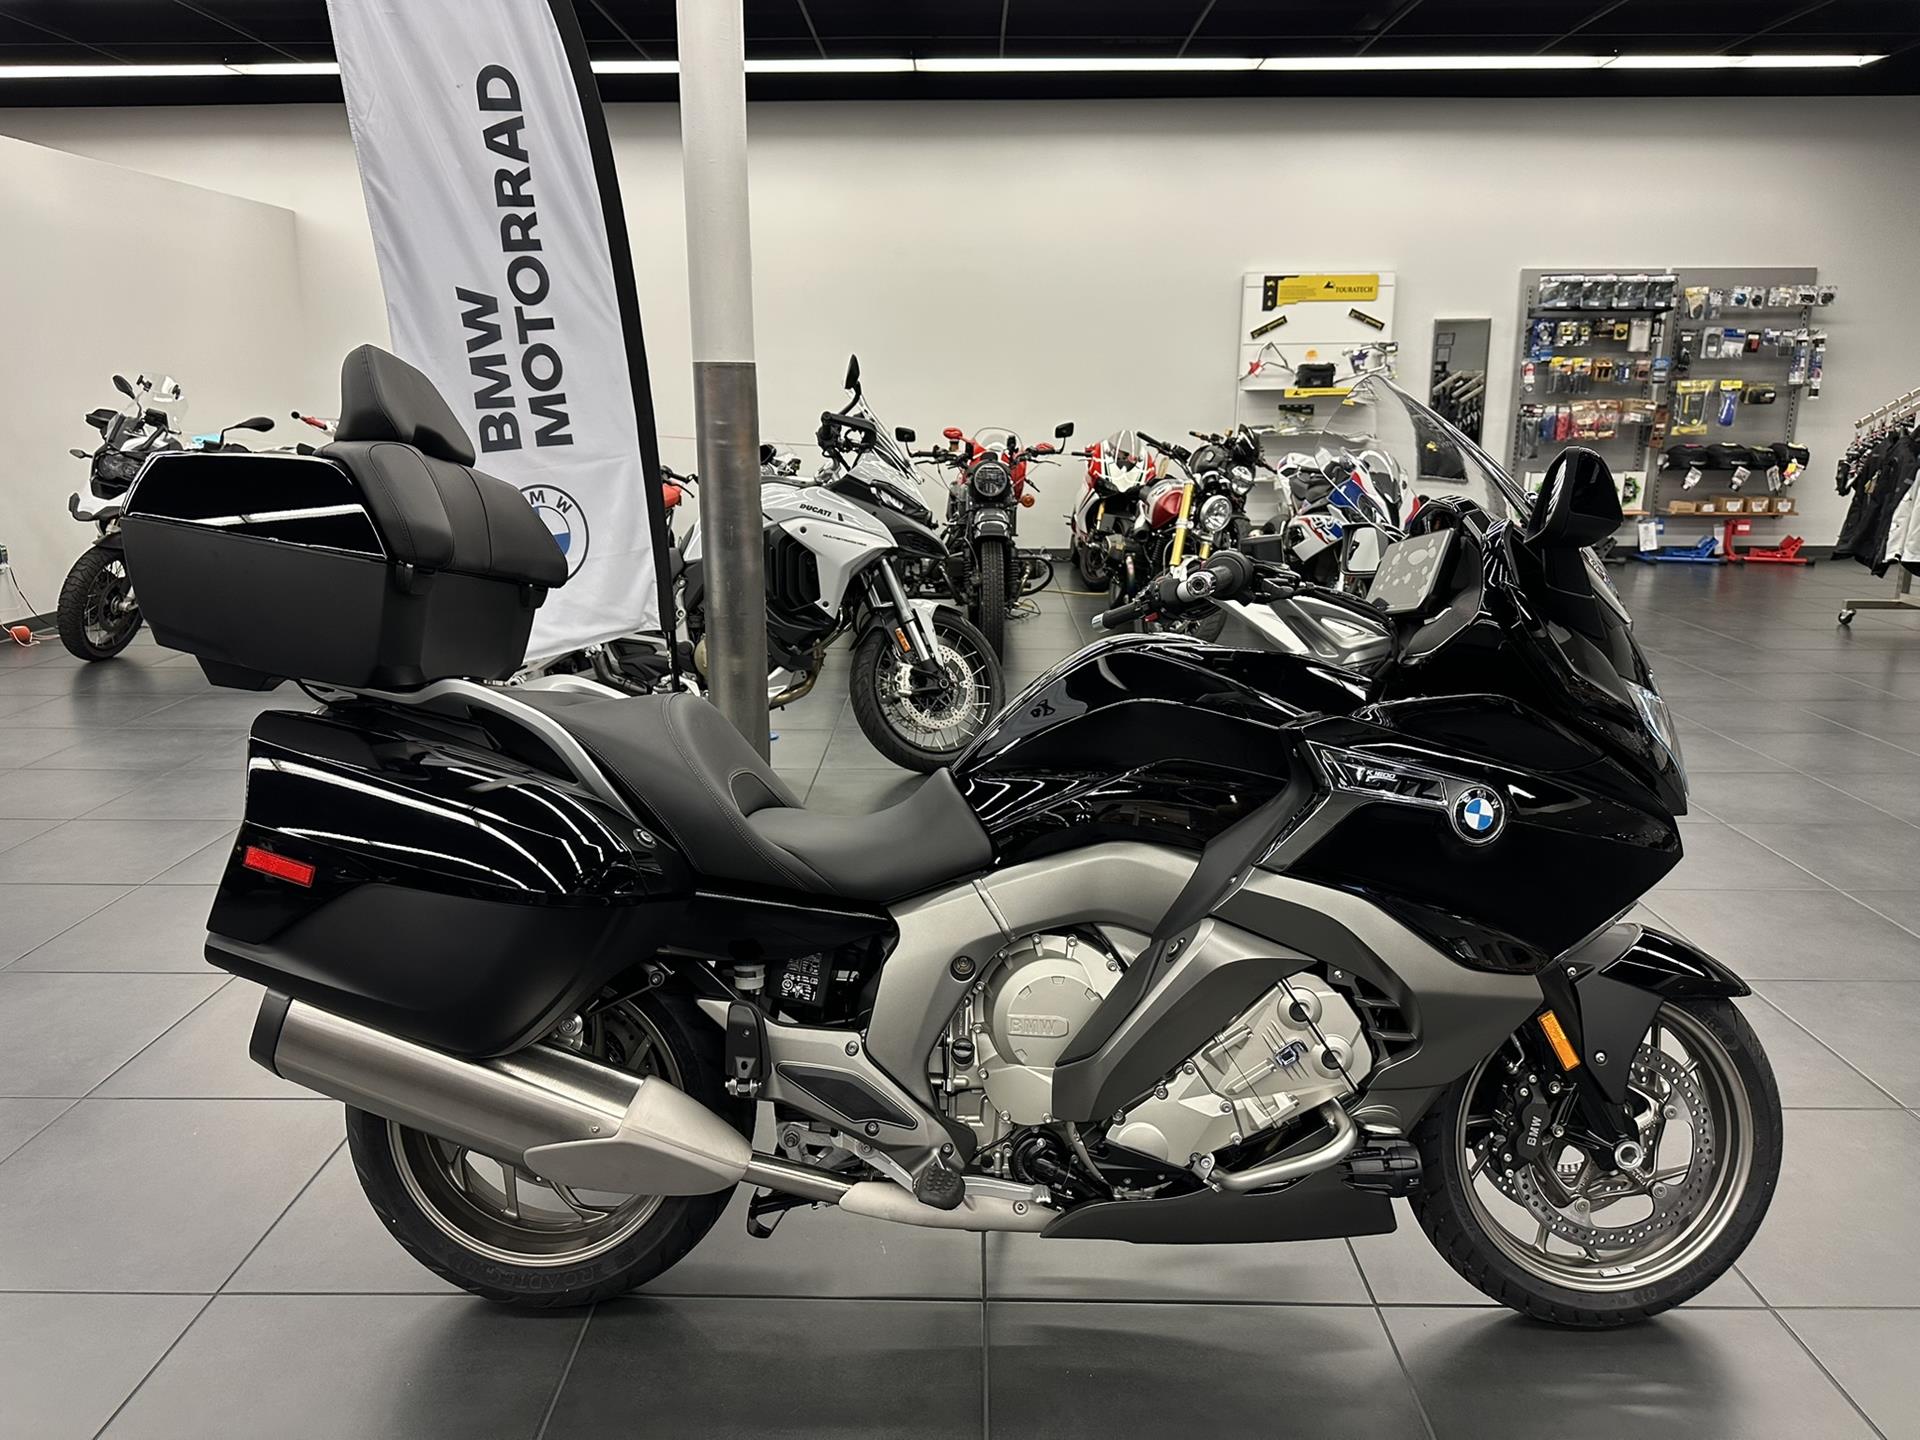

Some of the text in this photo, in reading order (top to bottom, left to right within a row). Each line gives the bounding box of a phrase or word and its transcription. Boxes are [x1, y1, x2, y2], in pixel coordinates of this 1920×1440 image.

[476, 64, 574, 447] MOTORRAD
[1335, 286, 1374, 294] TOURATECH
[455, 286, 522, 453] BMW
[529, 490, 573, 514] MW
[799, 503, 832, 517] DUCATI
[1460, 790, 1500, 809] BMW
[1009, 1017, 1056, 1035] BMW
[1527, 1115, 1542, 1146] BMW
